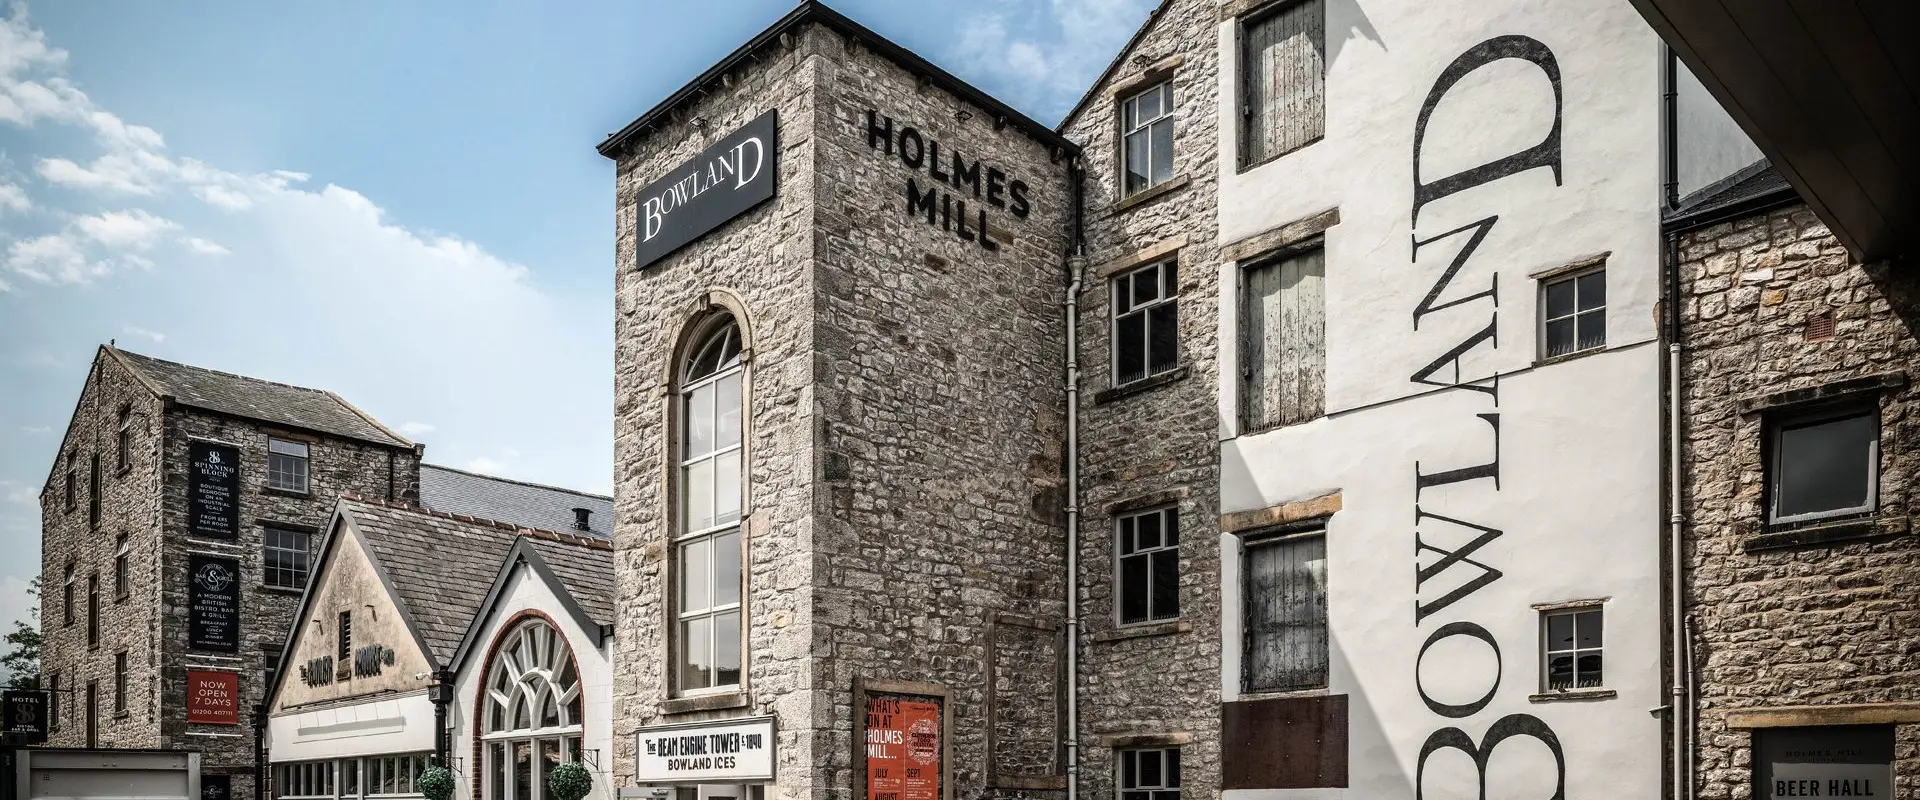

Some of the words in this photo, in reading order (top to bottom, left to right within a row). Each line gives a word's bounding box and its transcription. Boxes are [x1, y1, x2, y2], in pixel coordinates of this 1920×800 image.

[867, 109, 1030, 219] HOLMES
[642, 137, 764, 243] BOWLAND
[906, 177, 996, 252] MILL
[1410, 34, 1565, 800] BOWLAND
[194, 461, 234, 474] SPINNING
[201, 468, 228, 478] BLOCK
[200, 483, 228, 491] BOUTIQUE
[199, 488, 230, 497] BEDROOMS
[198, 498, 230, 507] INDUSTRIAL
[204, 593, 232, 601] MODERN
[201, 599, 227, 607] BRITISH
[200, 680, 226, 689] NOW
[198, 689, 228, 698] OPEN
[195, 697, 200, 705] 7
[204, 697, 231, 707] DAYS
[868, 698, 900, 714] WHAT'S
[868, 714, 880, 728] ON
[882, 715, 893, 729] AT
[868, 729, 903, 745] HOLMES
[657, 736, 678, 757] BEAM
[680, 734, 708, 756] ENGINE
[709, 732, 740, 754] TOWER
[668, 757, 712, 771] BOWLAND
[714, 756, 736, 769] ICES
[875, 768, 889, 778] JULY
[907, 768, 921, 778] SEPT
[1776, 779, 1820, 797] BEER
[1828, 779, 1874, 797] HALL
[875, 792, 898, 800] AUGUST
